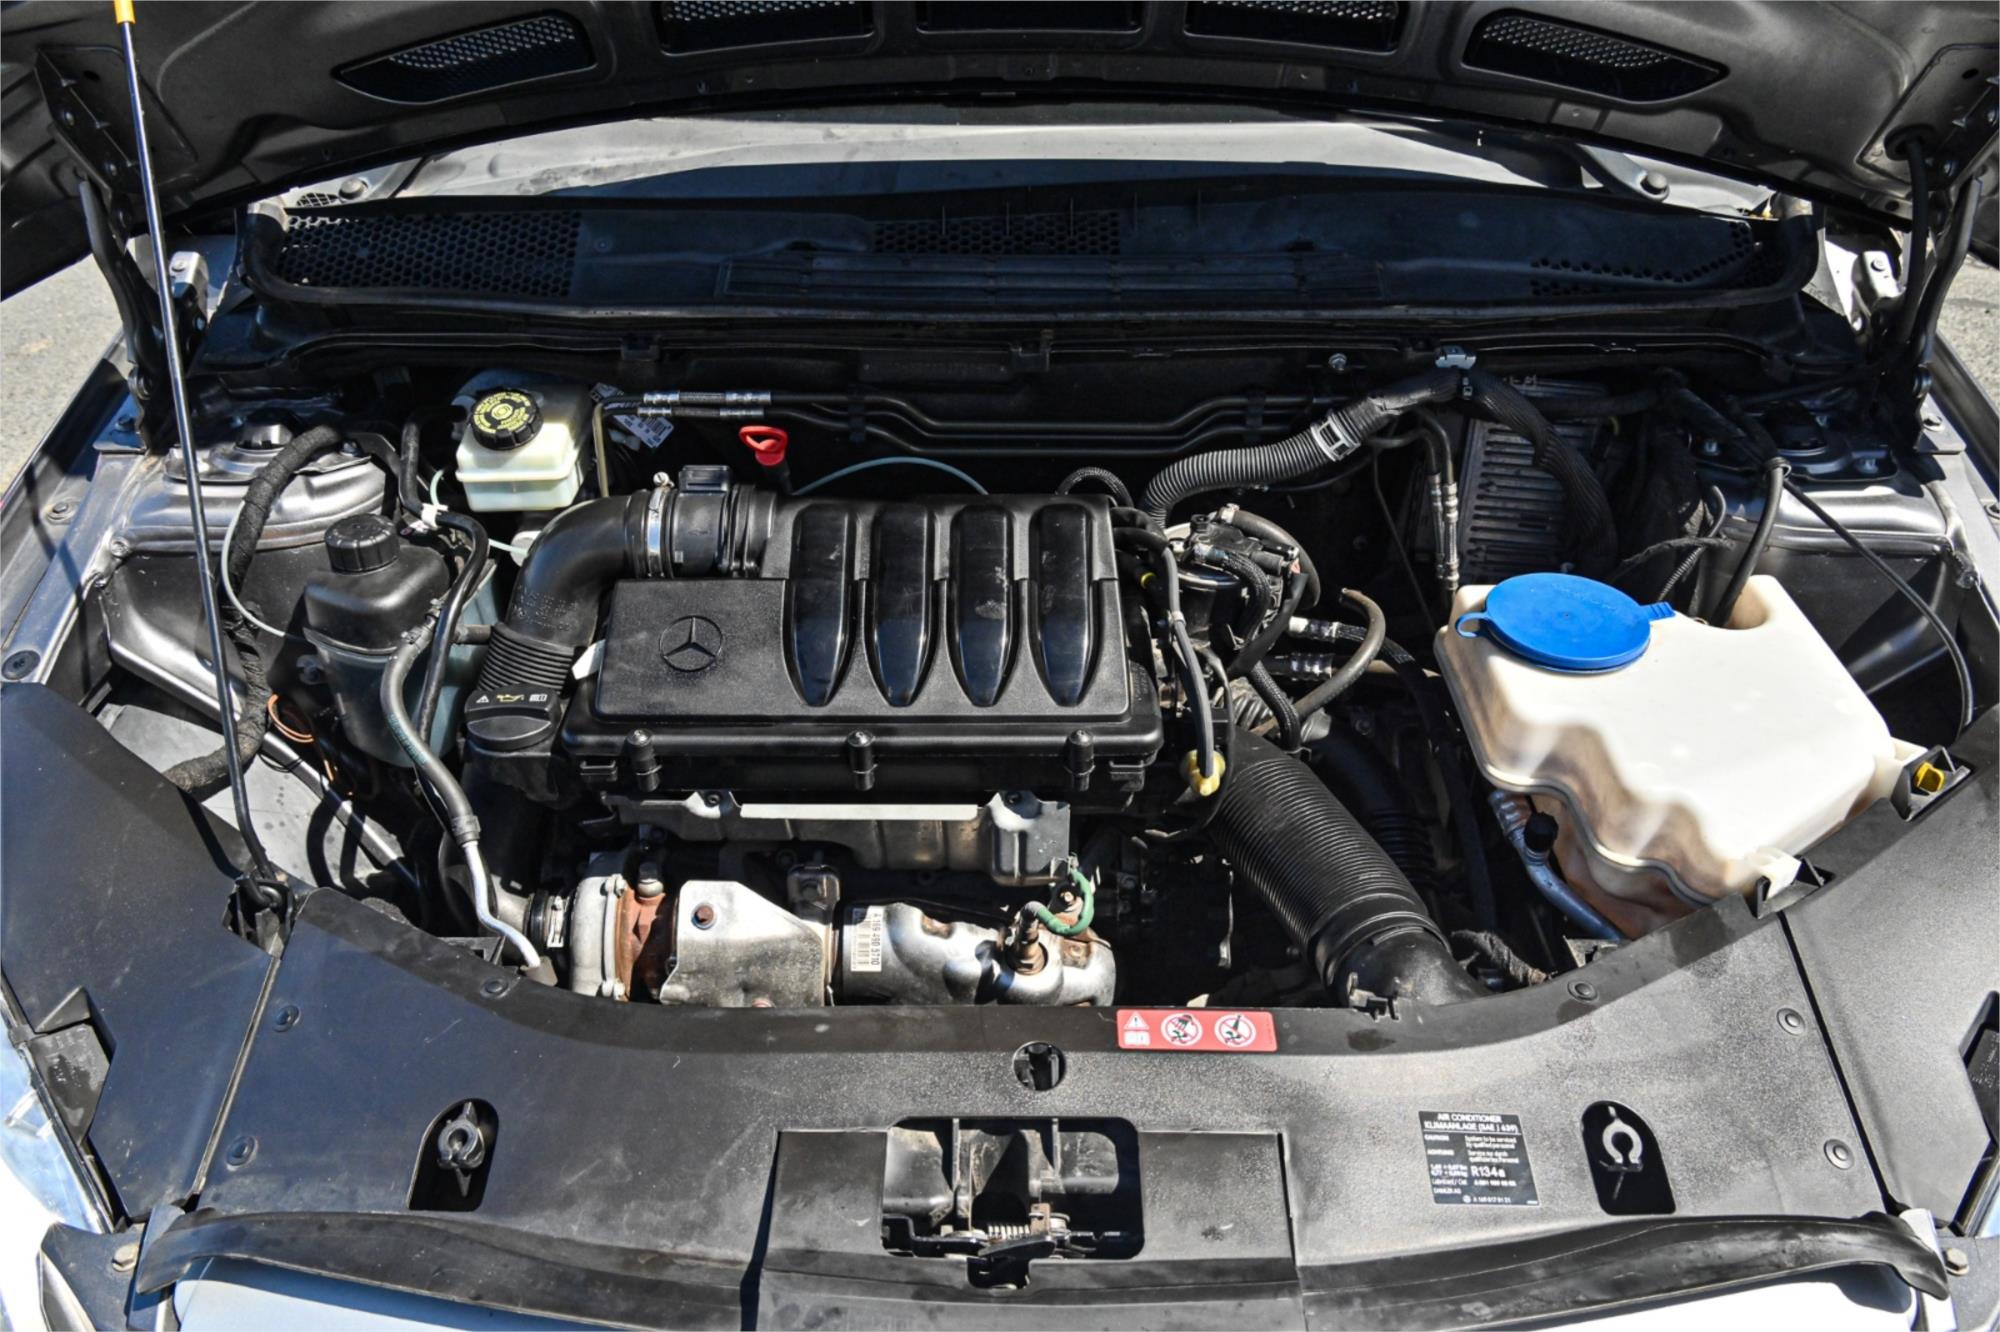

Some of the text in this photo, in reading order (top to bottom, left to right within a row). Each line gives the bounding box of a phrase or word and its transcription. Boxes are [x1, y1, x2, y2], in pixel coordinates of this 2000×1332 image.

[1437, 1113, 1502, 1123] AIR CONDITIONER
[1423, 1120, 1477, 1130] KLIMAANLAGE
[1470, 1165, 1506, 1178] R134a
